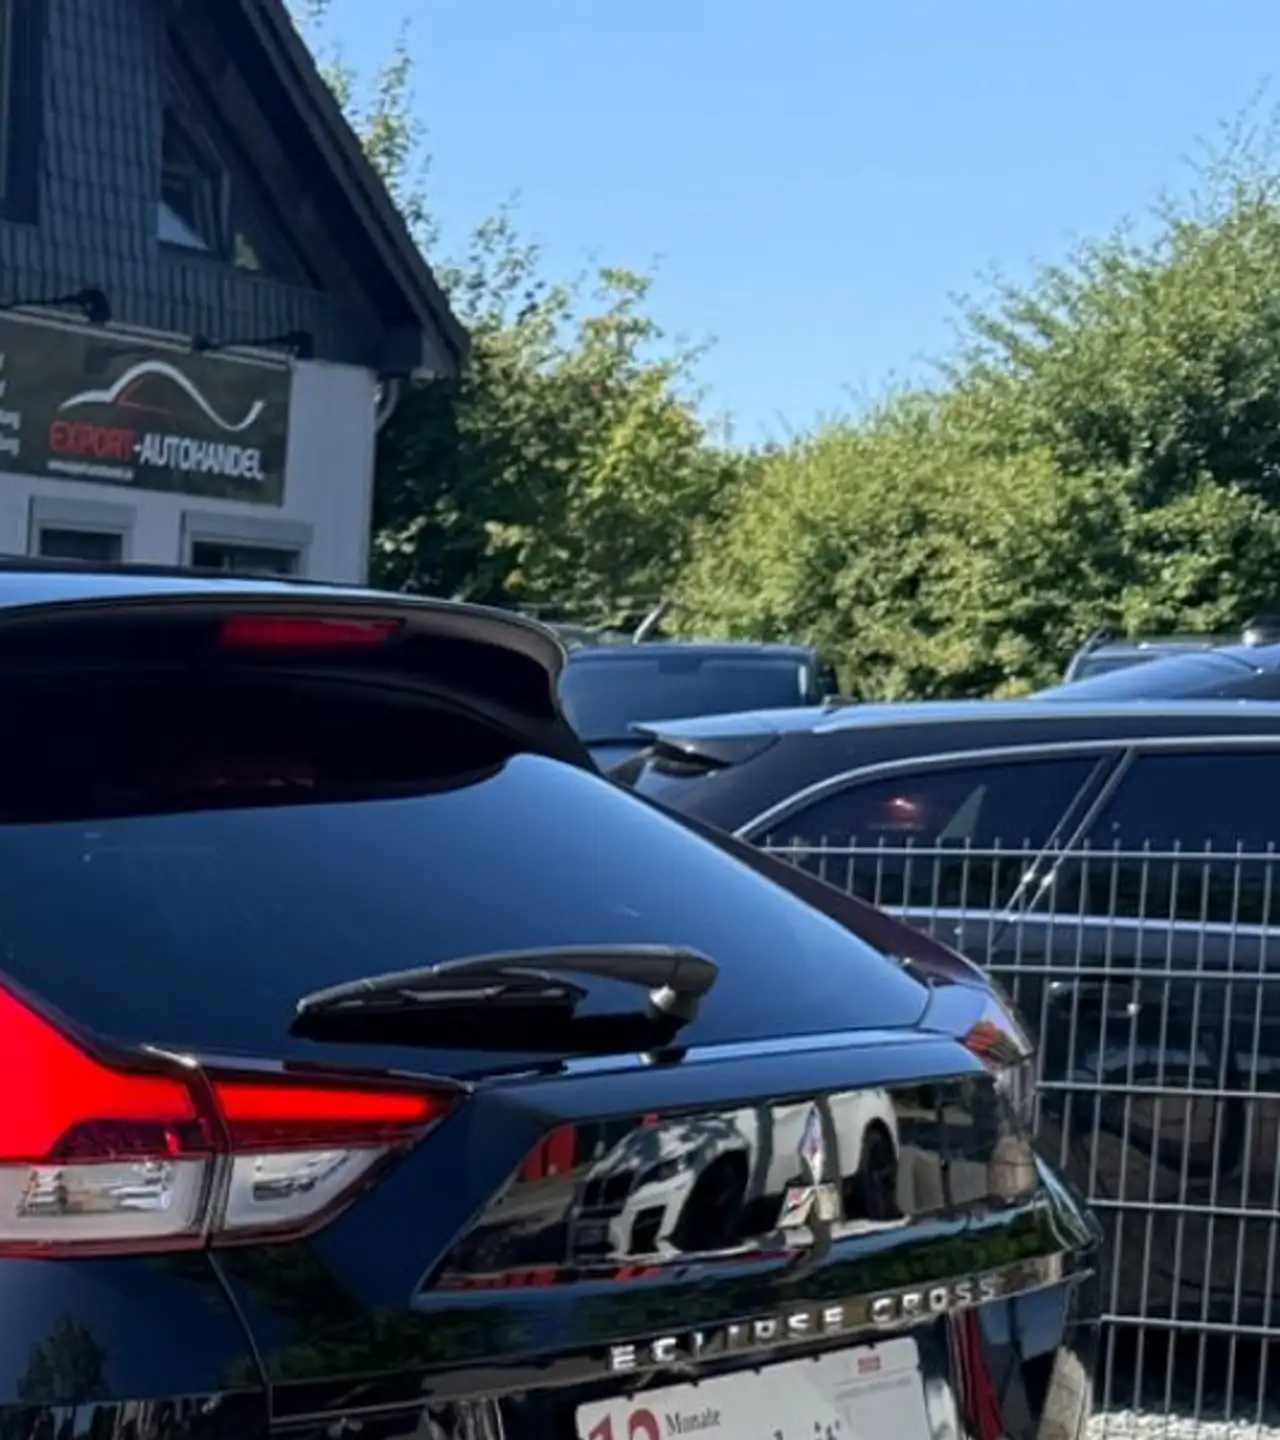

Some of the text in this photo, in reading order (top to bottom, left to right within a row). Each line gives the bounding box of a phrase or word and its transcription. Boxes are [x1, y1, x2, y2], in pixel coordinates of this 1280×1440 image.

[609, 1279, 997, 1372] ECLIPSE CROSS
[665, 1406, 722, 1437] Monate
